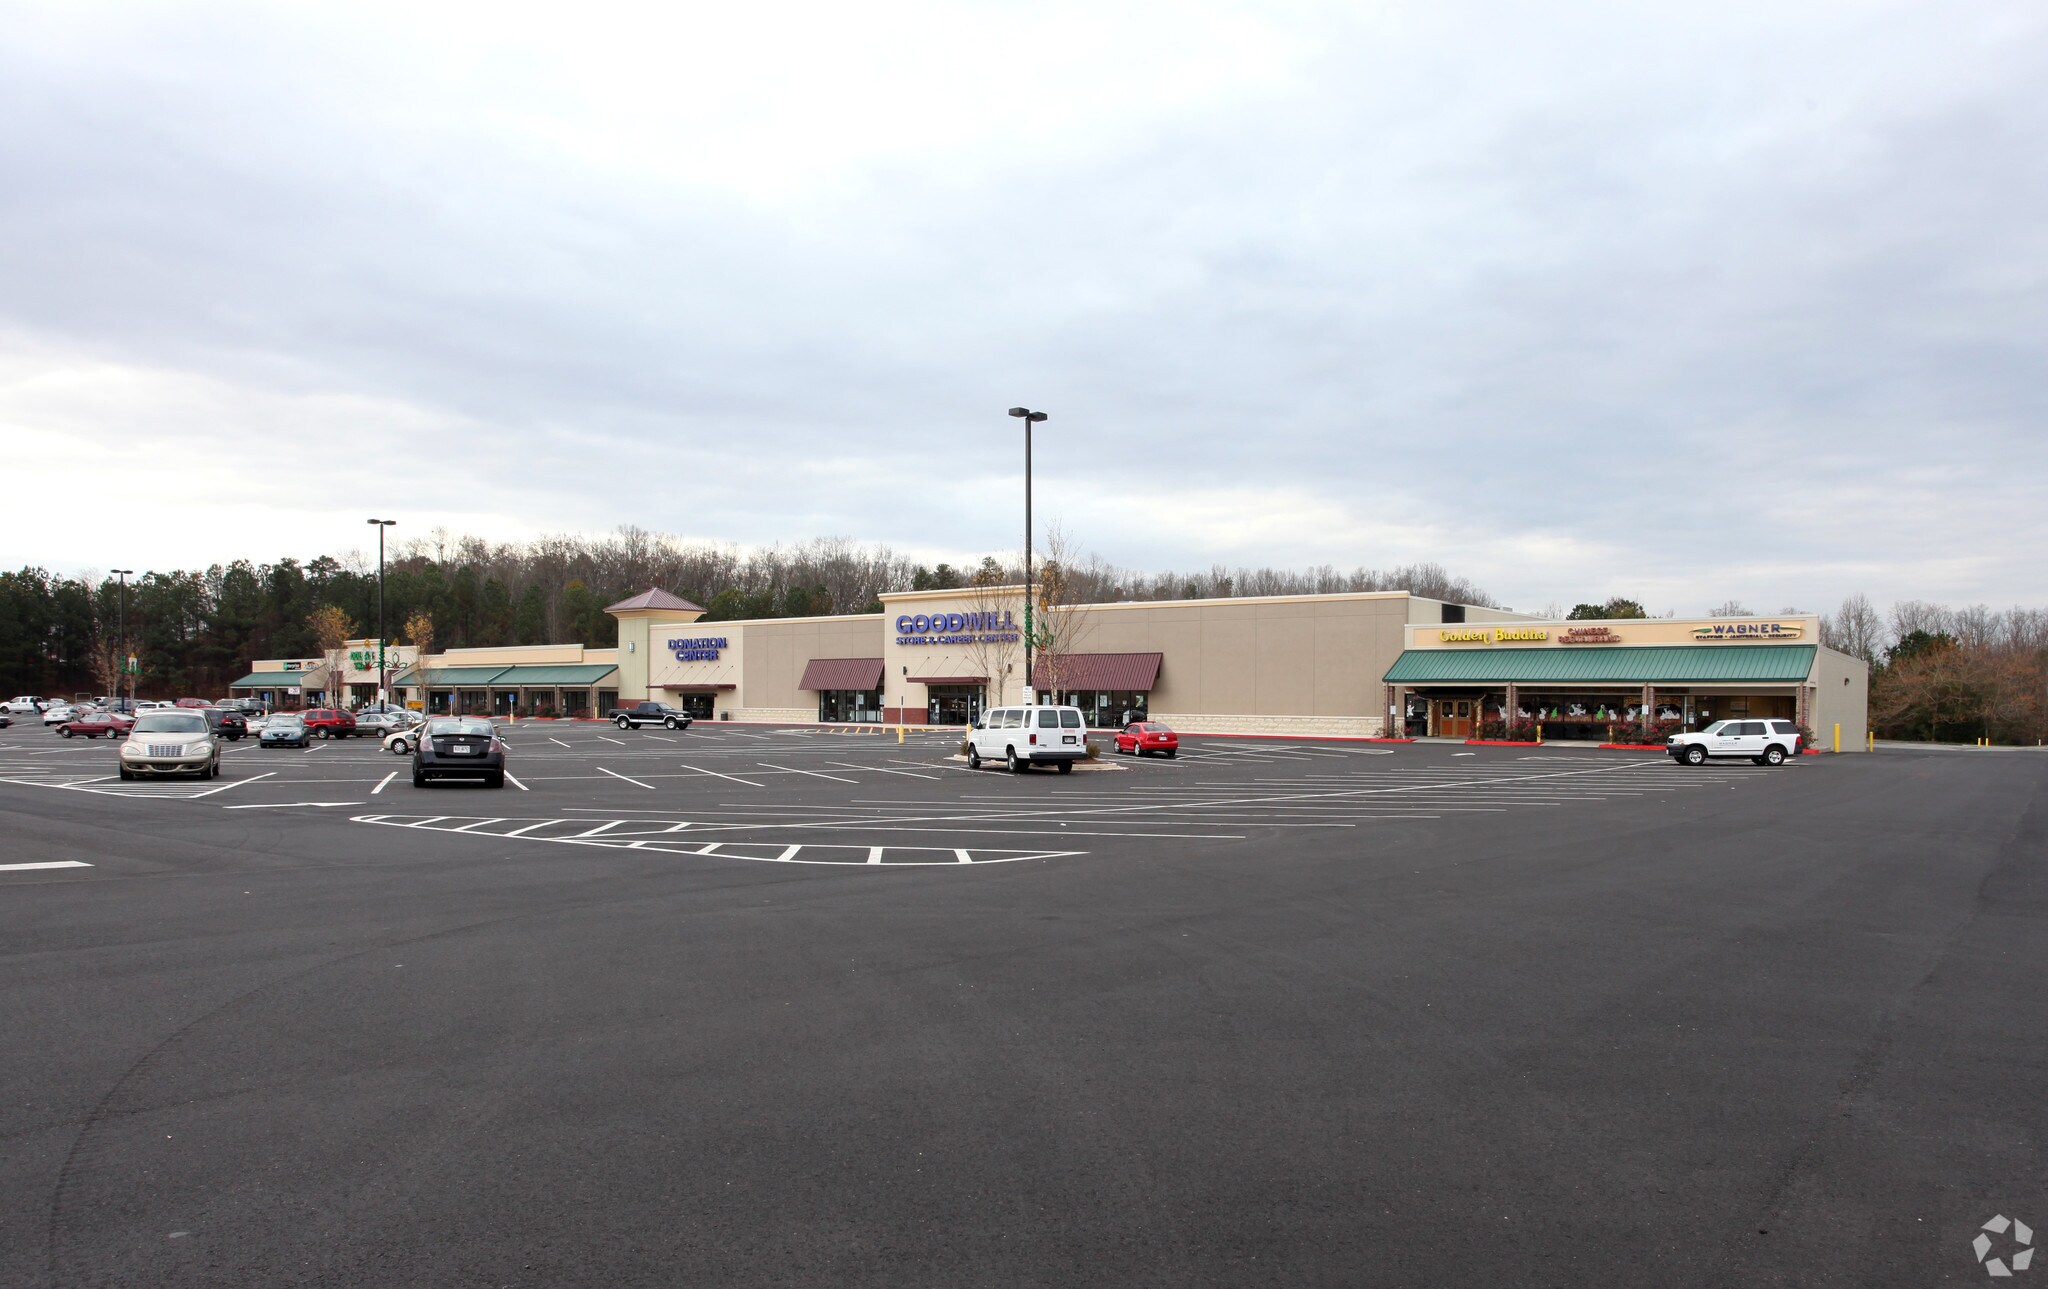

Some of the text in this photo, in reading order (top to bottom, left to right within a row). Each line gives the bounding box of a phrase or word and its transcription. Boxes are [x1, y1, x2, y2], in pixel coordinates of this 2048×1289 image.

[896, 610, 1018, 634] GOODWILL
[1567, 627, 1610, 636] CHINESE
[1713, 624, 1780, 634] WAGNER
[896, 636, 926, 645] STORE
[937, 634, 975, 644] CAREER
[978, 633, 1018, 643] CENTER
[1439, 628, 1548, 644] Golden Buddha
[1558, 635, 1621, 644] RESTAURANT
[668, 637, 727, 650] DONATION
[675, 649, 719, 662] CENTER
